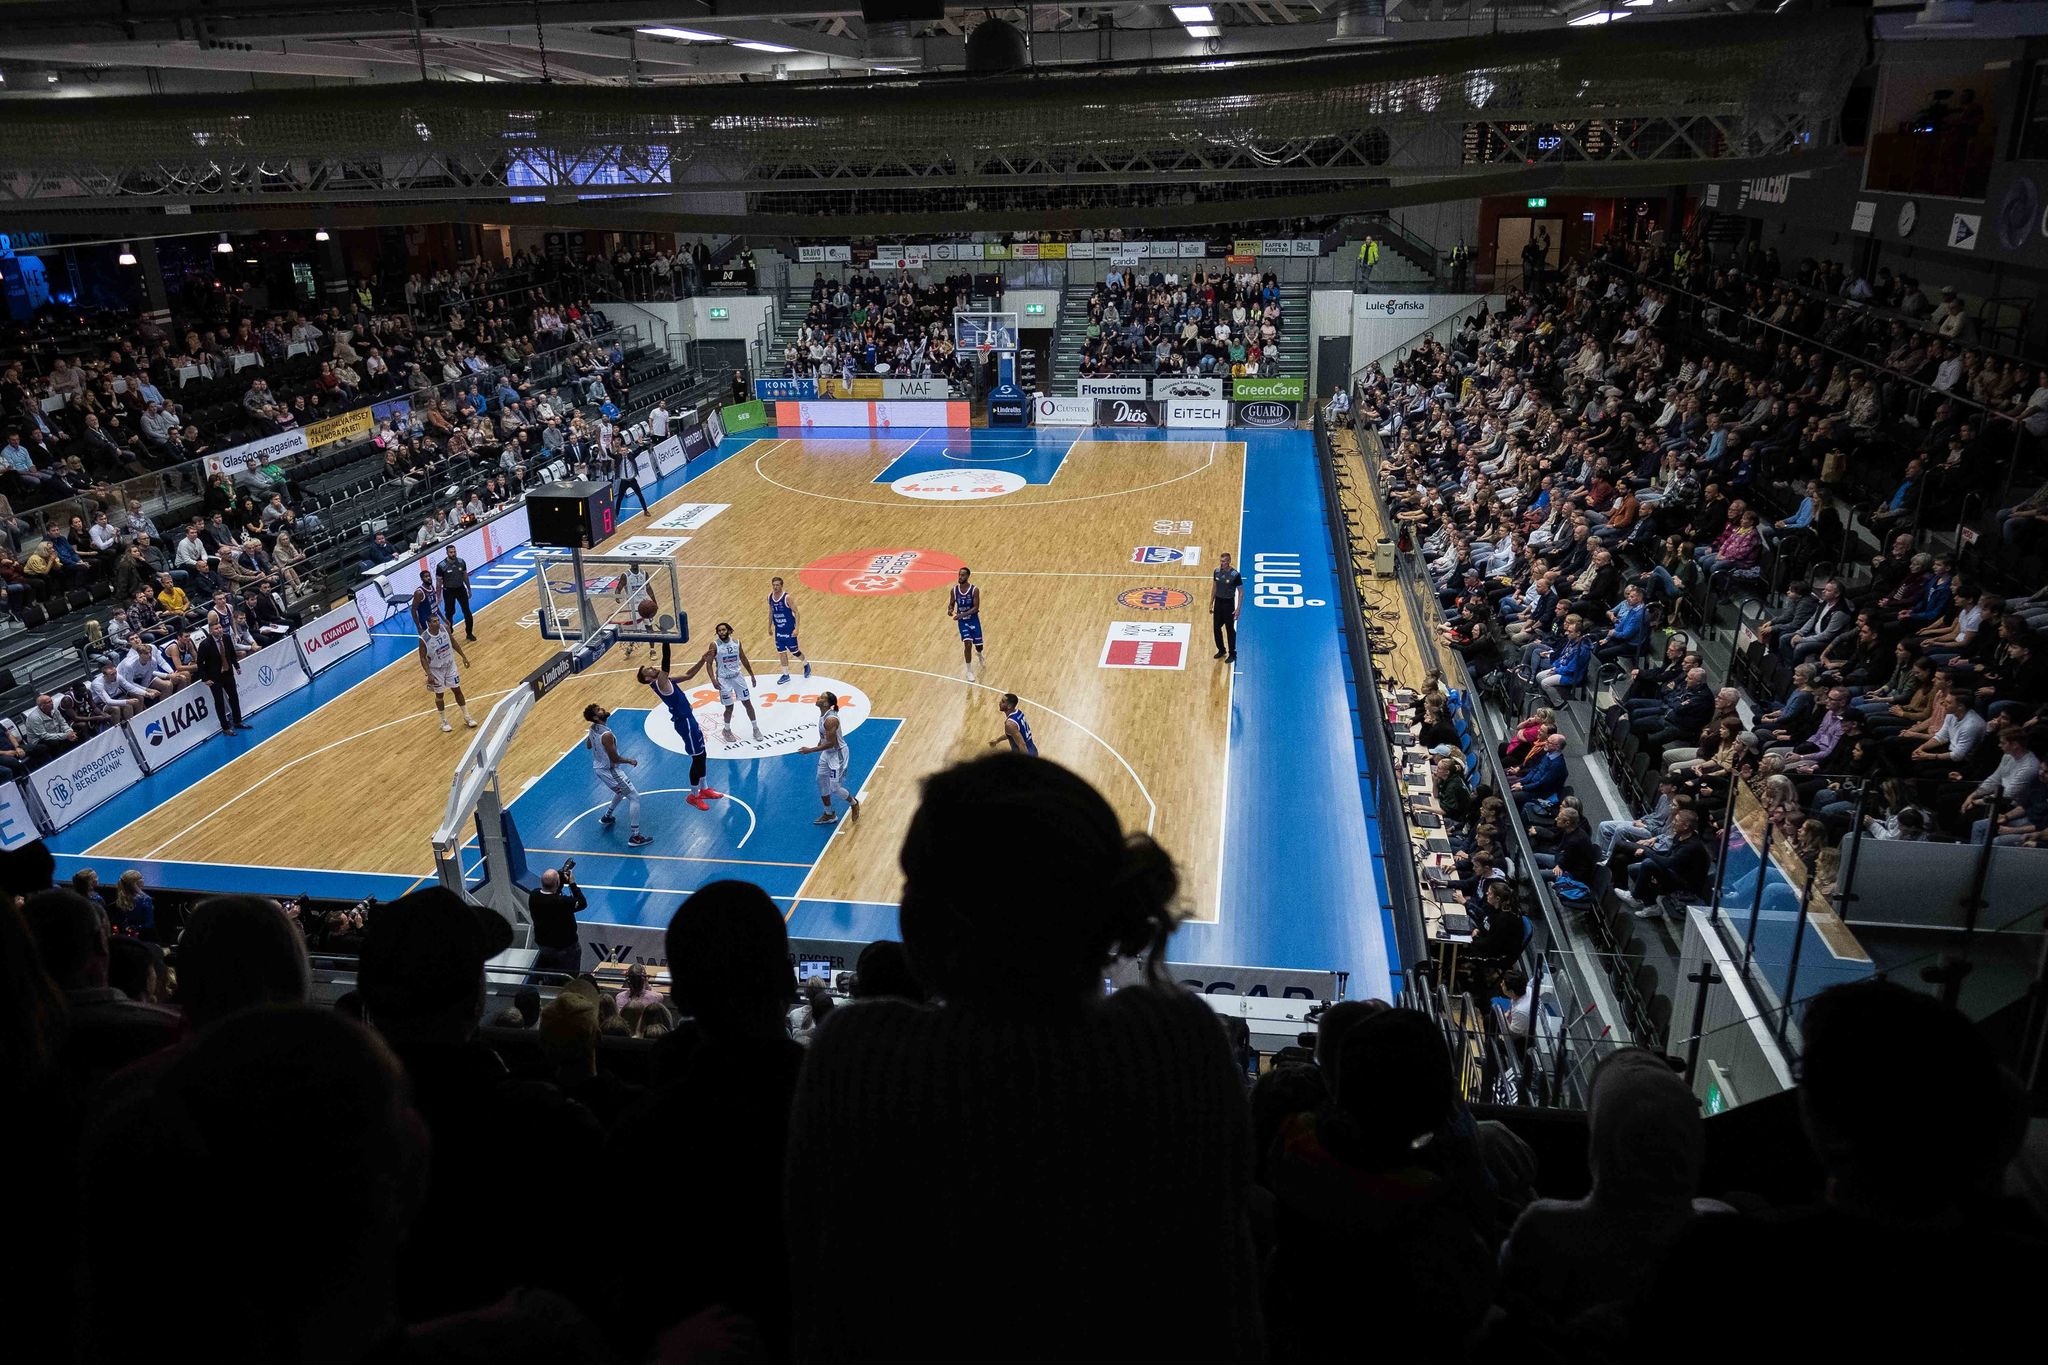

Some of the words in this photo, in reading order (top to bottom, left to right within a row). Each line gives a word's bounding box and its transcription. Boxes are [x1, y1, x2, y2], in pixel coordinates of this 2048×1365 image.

[899, 382, 931, 395] MAF
[1081, 385, 1142, 395] Flemströms
[1236, 382, 1300, 395] GreenCare
[737, 412, 751, 421] SEB
[1112, 400, 1148, 423] Diös
[1248, 405, 1284, 417] GUARD
[310, 422, 331, 436] ALLTID
[330, 416, 349, 429] HALVA
[348, 411, 369, 424] PRISET
[320, 429, 341, 443] ANDRA
[222, 435, 303, 469] Glasögonmagasinet
[322, 619, 358, 644] KVANTUM
[304, 636, 322, 655] ICA
[436, 636, 443, 646] 17
[726, 646, 733, 654] 12
[542, 659, 570, 687] Lindroths
[162, 696, 209, 739] LKAB
[784, 723, 817, 734] SOM
[723, 739, 751, 751] UPP
[773, 734, 803, 745] FÖR
[72, 745, 125, 782] NORRBOTTENS
[75, 759, 123, 792] BERGTEKNIK
